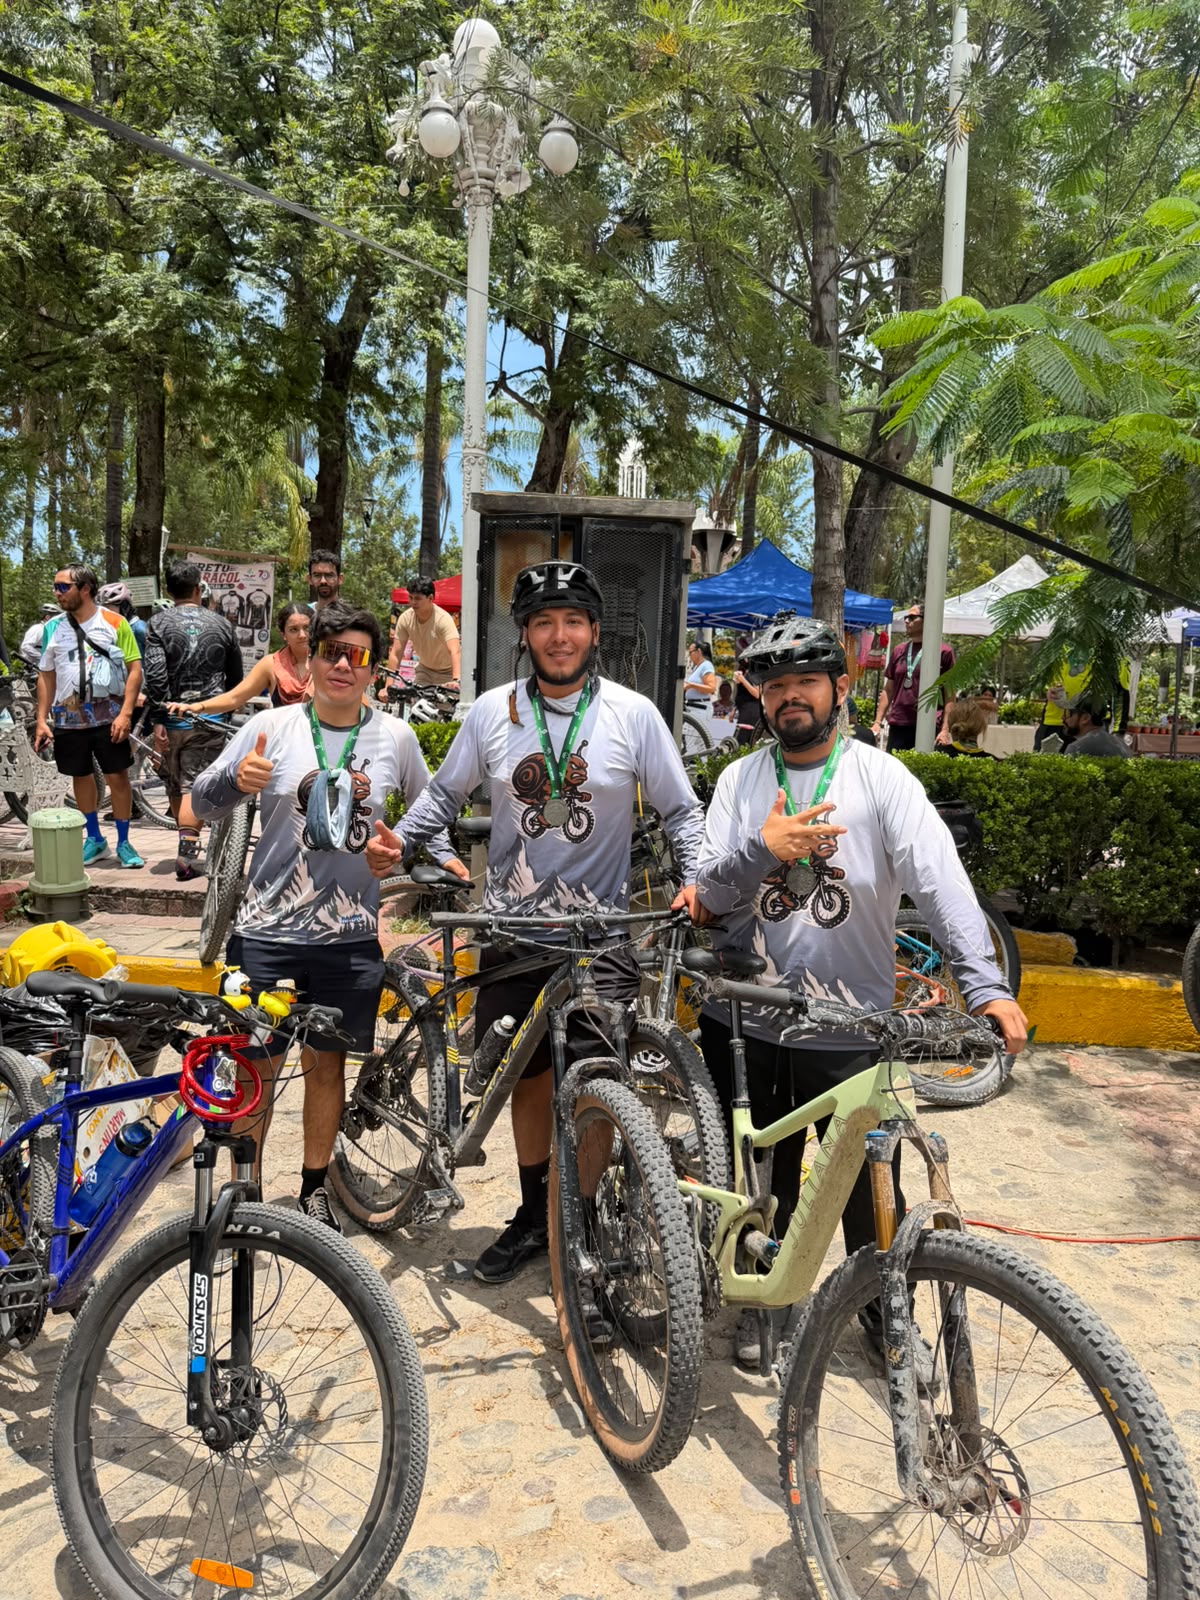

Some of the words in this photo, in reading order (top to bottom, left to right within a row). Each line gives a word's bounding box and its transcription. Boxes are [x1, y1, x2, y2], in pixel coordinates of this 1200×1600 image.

[198, 562, 230, 573] RETO
[202, 571, 241, 584] RACOL
[98, 1107, 127, 1154] MARTINS
[788, 1114, 847, 1250] JULIANA
[225, 1223, 281, 1240] NDA
[194, 1273, 208, 1298] SR
[193, 1299, 208, 1354] SUNTOUR
[1099, 1386, 1163, 1537] MAXXIS
